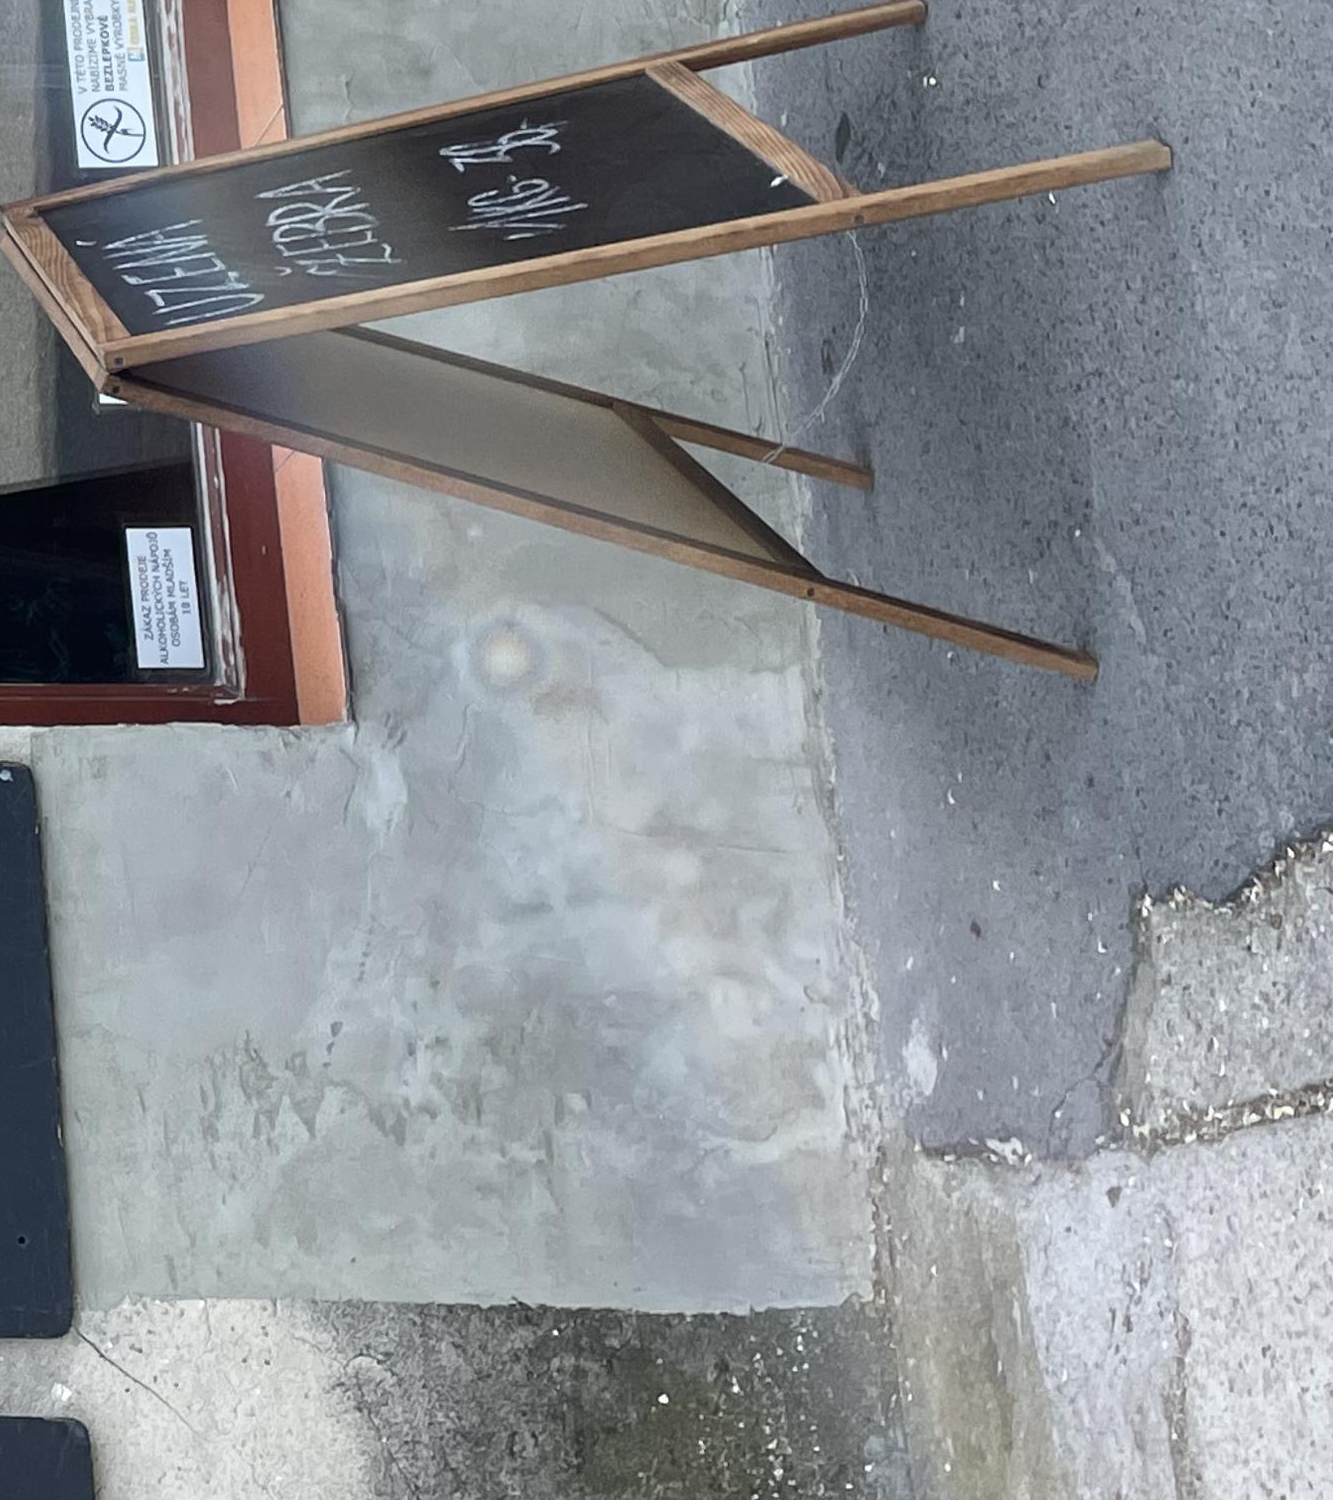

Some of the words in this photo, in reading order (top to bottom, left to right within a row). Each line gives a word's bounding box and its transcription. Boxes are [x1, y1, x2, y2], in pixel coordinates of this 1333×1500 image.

[74, 54, 86, 83] TÉTO
[97, 15, 115, 92] BEZLEPKOVÉ
[114, 53, 128, 91] MASNÉ
[78, 87, 87, 95] V
[253, 169, 403, 277] ŽEBRA
[75, 218, 265, 325] UZENÁ
[137, 556, 150, 602] PRODEJE
[162, 549, 176, 598] MLADŠÍM
[179, 579, 190, 599] LET
[141, 605, 154, 641] ZÁKAZ
[151, 576, 169, 664] ALKOHOLICKÝCH
[167, 601, 181, 647] OSOBÁM
